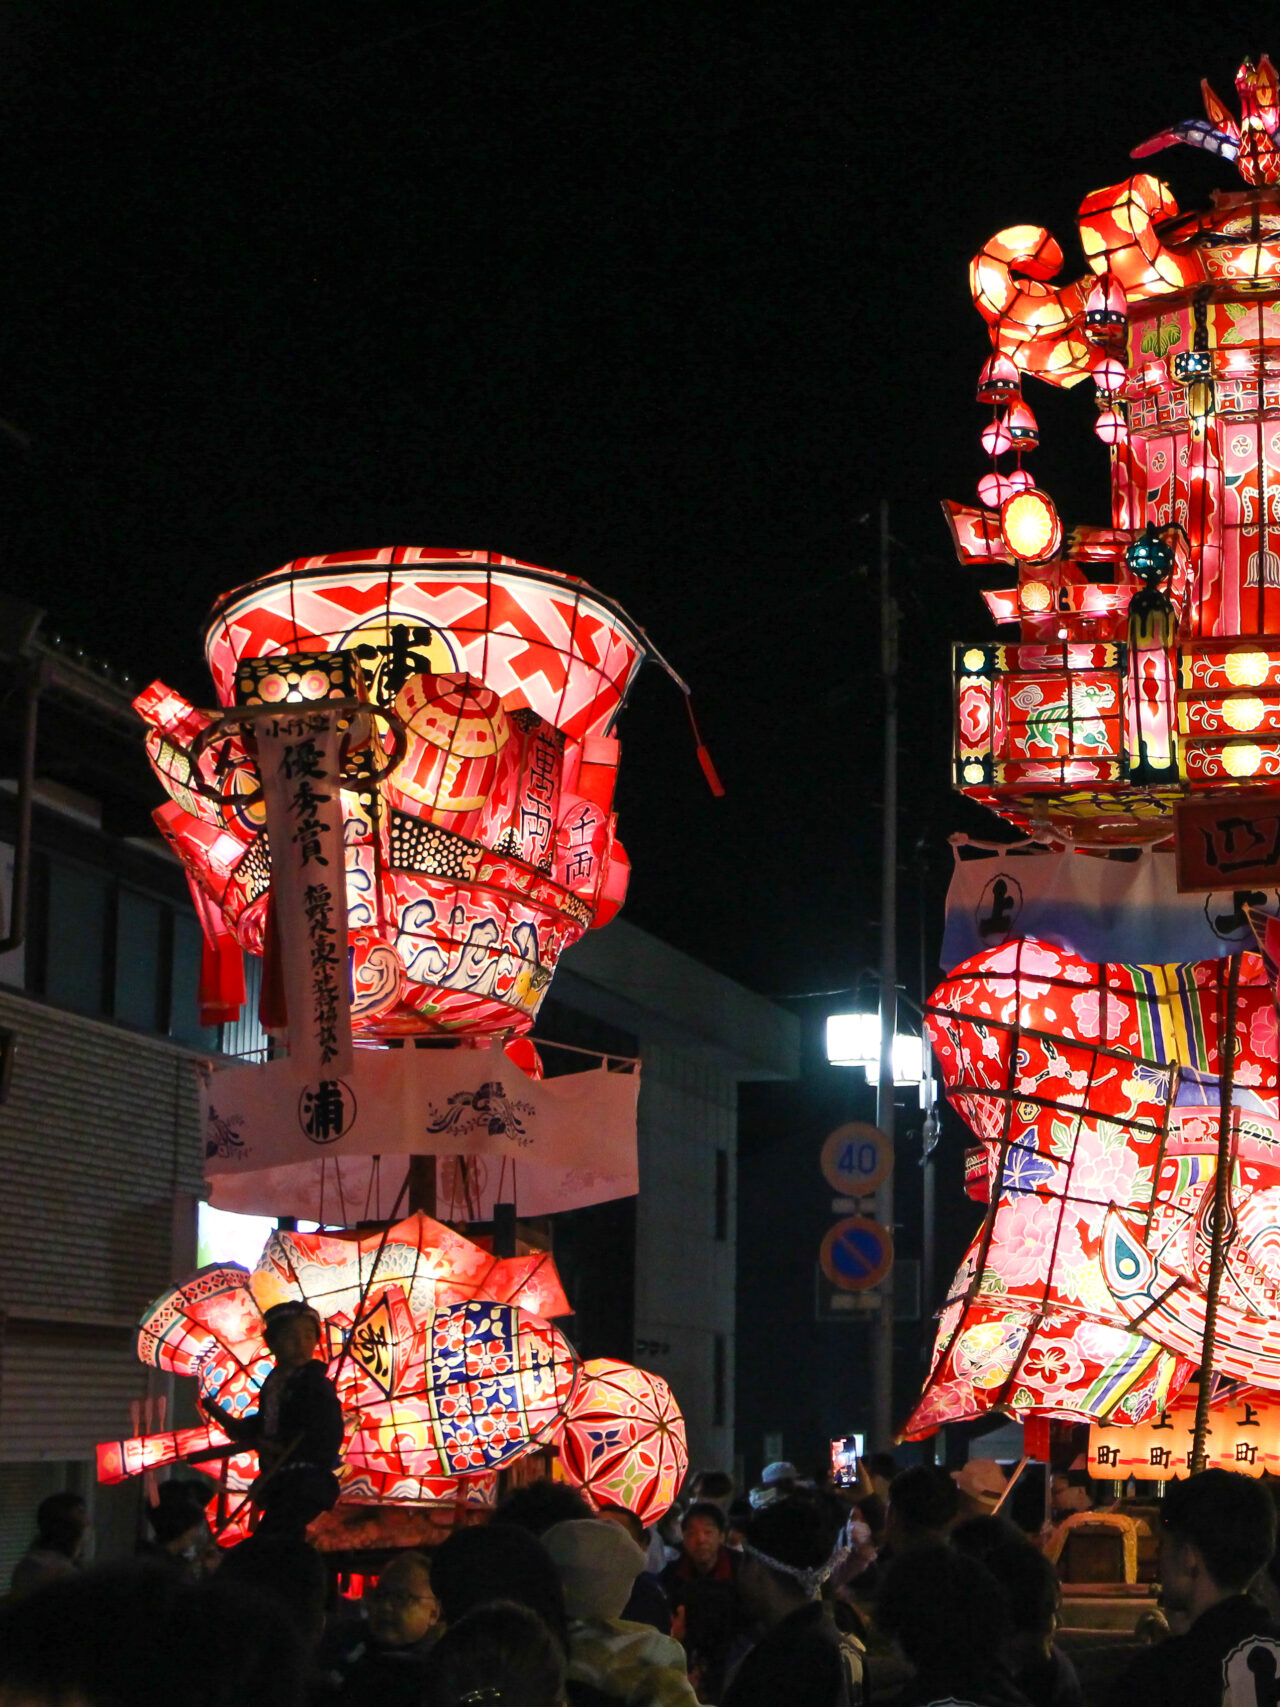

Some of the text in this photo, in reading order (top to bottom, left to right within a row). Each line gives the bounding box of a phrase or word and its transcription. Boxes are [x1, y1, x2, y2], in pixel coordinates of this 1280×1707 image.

[278, 738, 332, 867] 優秀賞
[303, 1080, 345, 1141] 浦
[838, 1143, 877, 1175] 40
[1236, 1403, 1260, 1464] 上町
